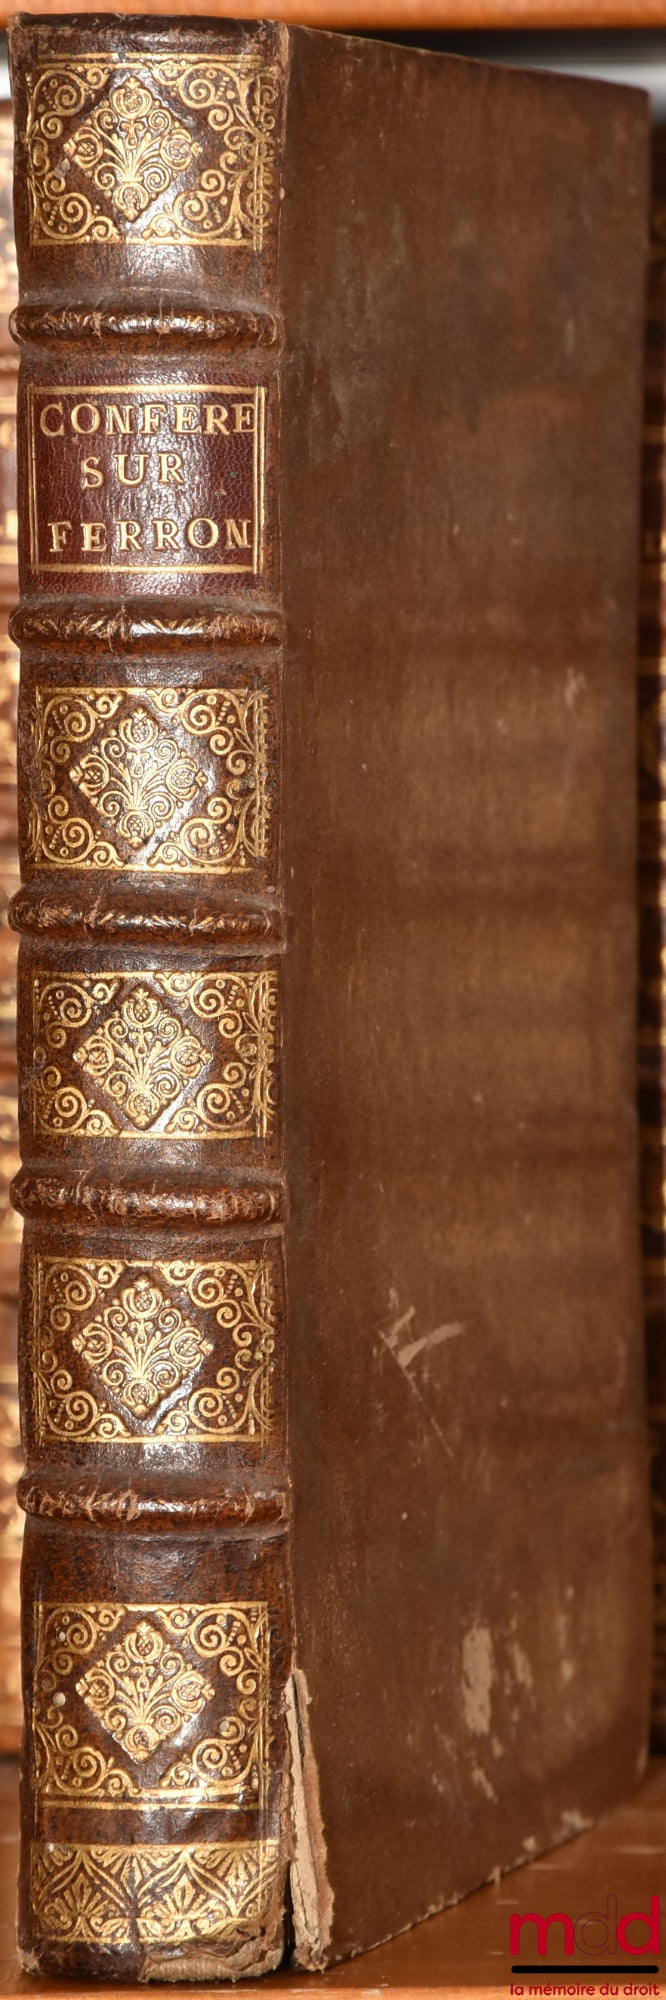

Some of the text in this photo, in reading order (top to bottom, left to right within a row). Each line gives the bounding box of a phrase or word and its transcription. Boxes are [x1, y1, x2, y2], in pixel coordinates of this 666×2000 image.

[39, 401, 256, 437] CONFERE
[81, 453, 185, 489] SUR
[47, 517, 252, 552] FERRON
